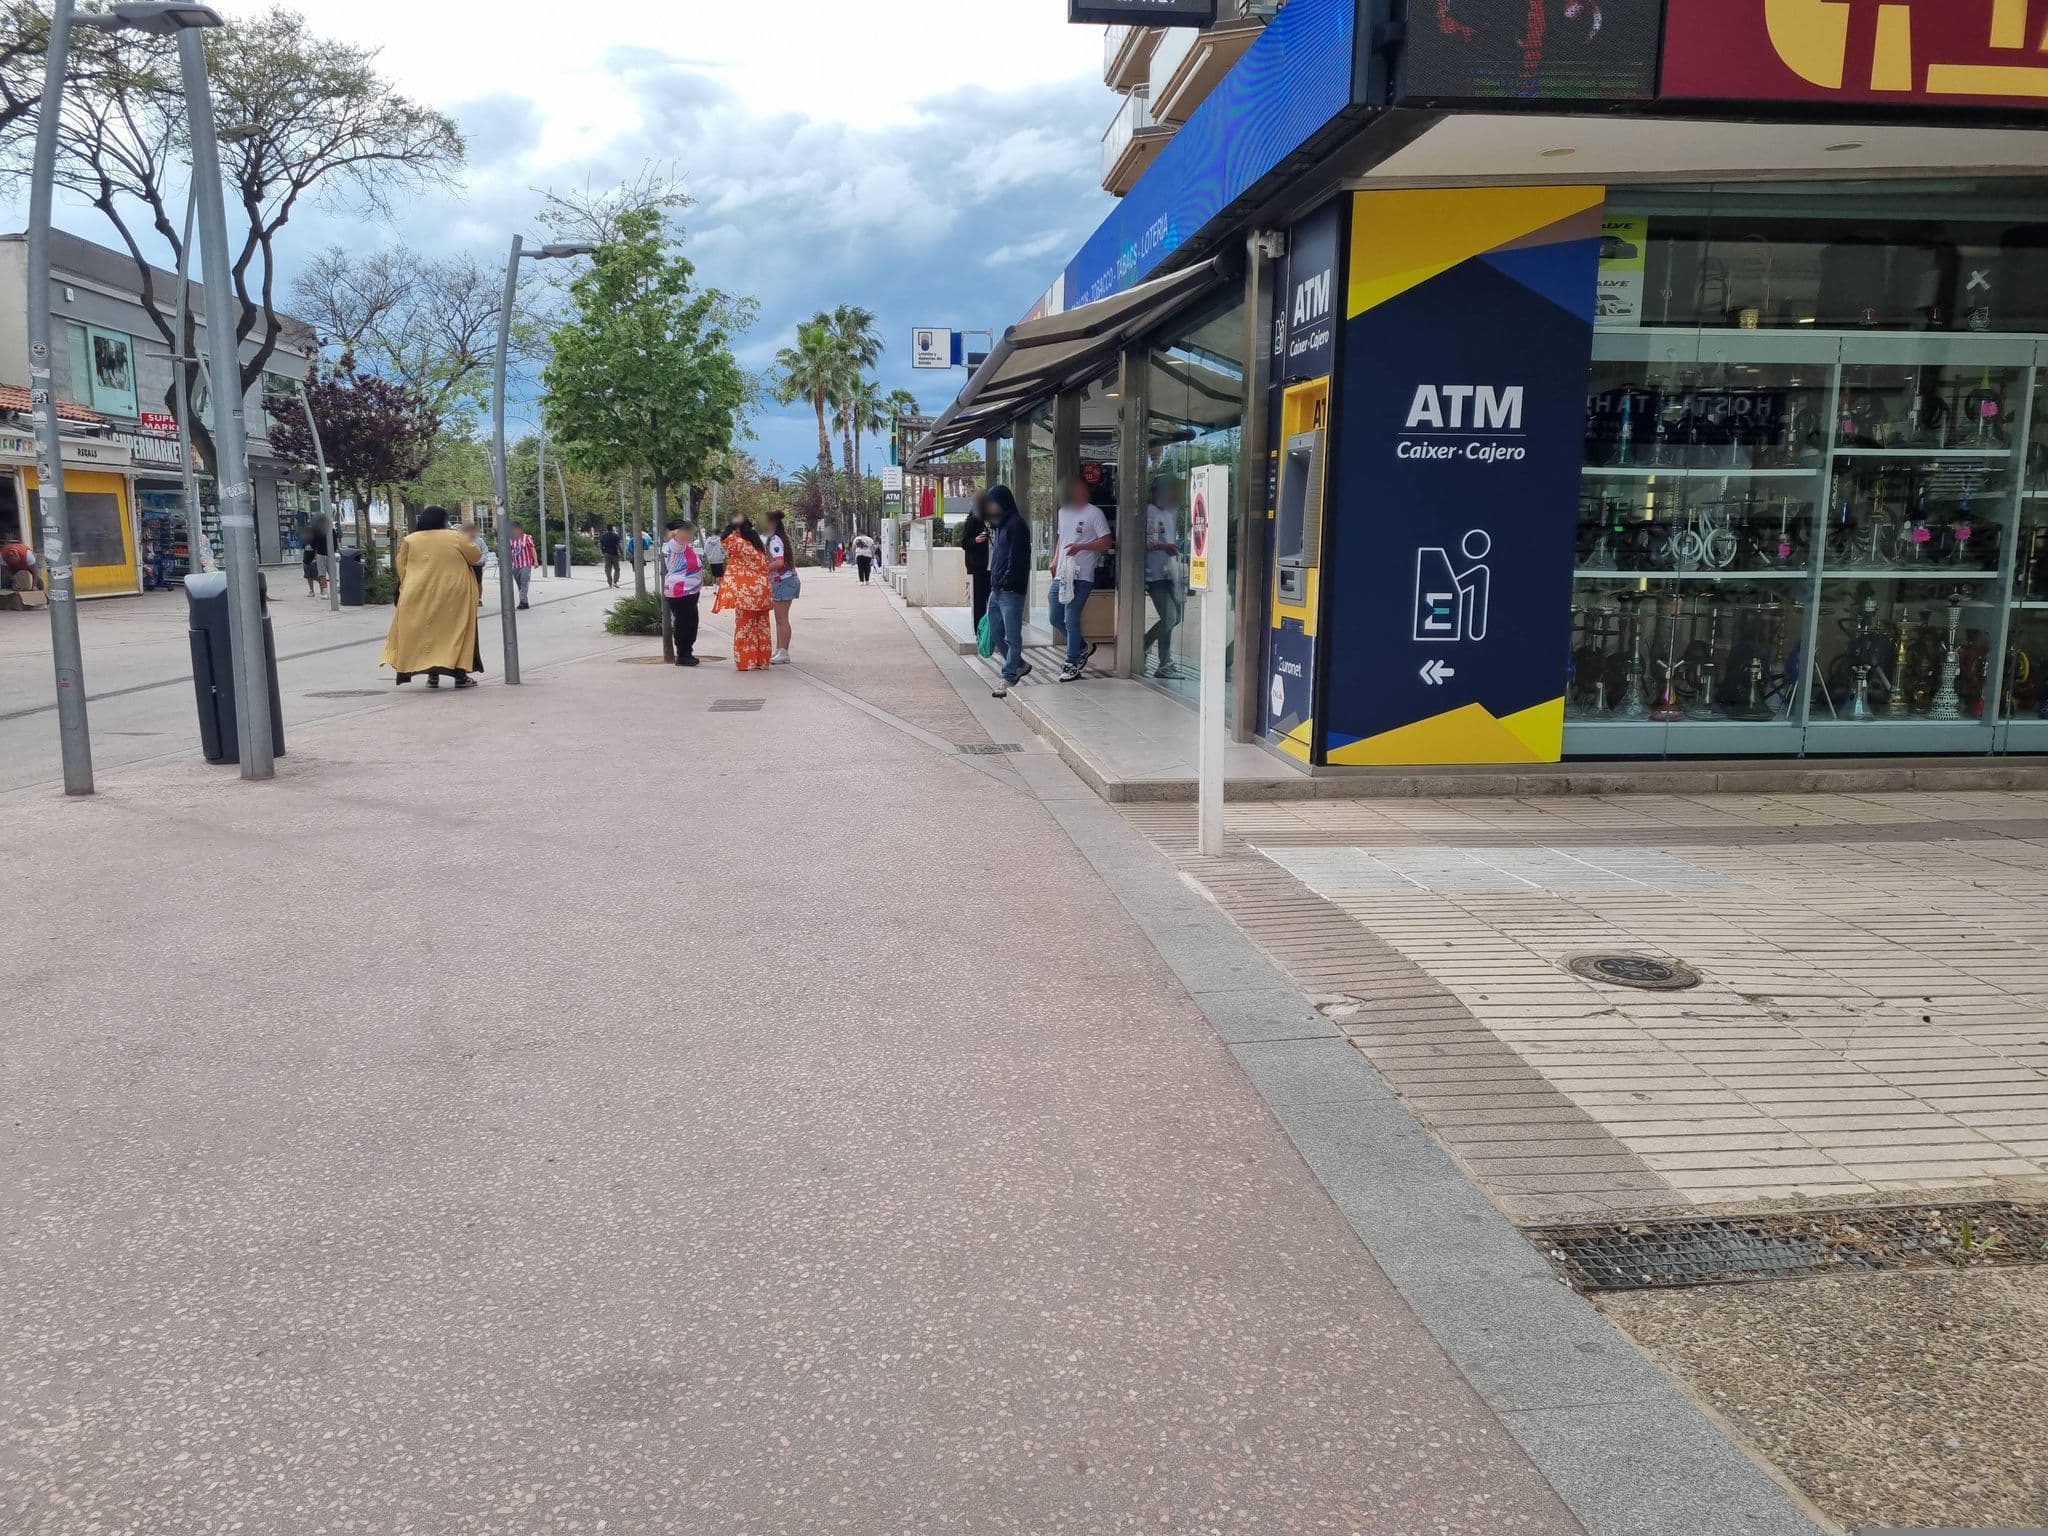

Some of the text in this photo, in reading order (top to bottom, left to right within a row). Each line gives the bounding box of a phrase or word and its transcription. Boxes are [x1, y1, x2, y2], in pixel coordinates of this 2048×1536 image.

[1293, 269, 1331, 327] ATM
[1405, 384, 1524, 428] ATM
[885, 493, 900, 501] ATM
